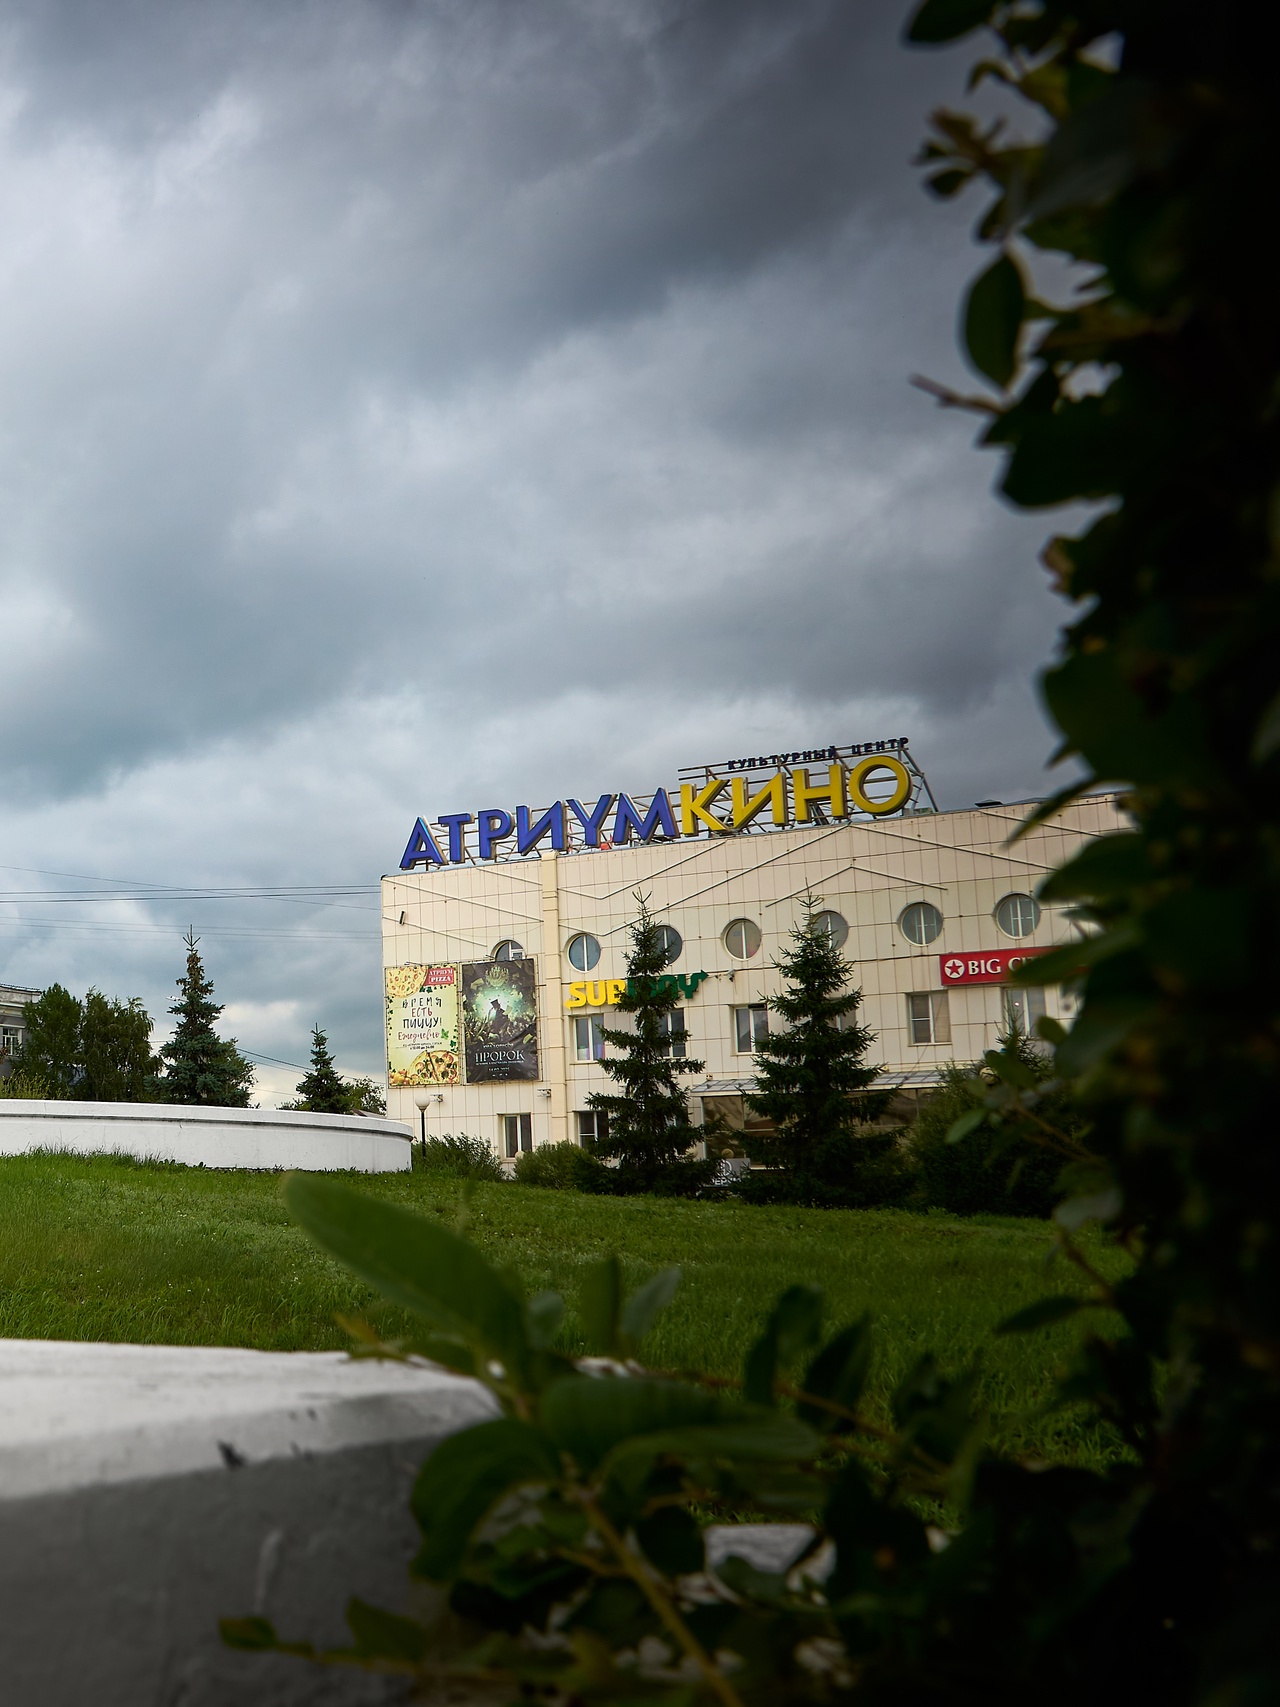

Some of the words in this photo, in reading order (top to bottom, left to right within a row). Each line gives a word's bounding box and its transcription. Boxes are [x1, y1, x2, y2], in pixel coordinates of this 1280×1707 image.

[728, 745, 836, 770] КУЛЬТУРНЫЙ
[851, 737, 909, 755] ЦЕНТР
[968, 958, 1001, 975] BIG
[402, 996, 442, 1008] ВРЕМЯ
[411, 1007, 433, 1017] ЕСТЬ
[402, 1017, 442, 1029] ПИЦЦУ!
[475, 1050, 526, 1062] ПРОРОК
